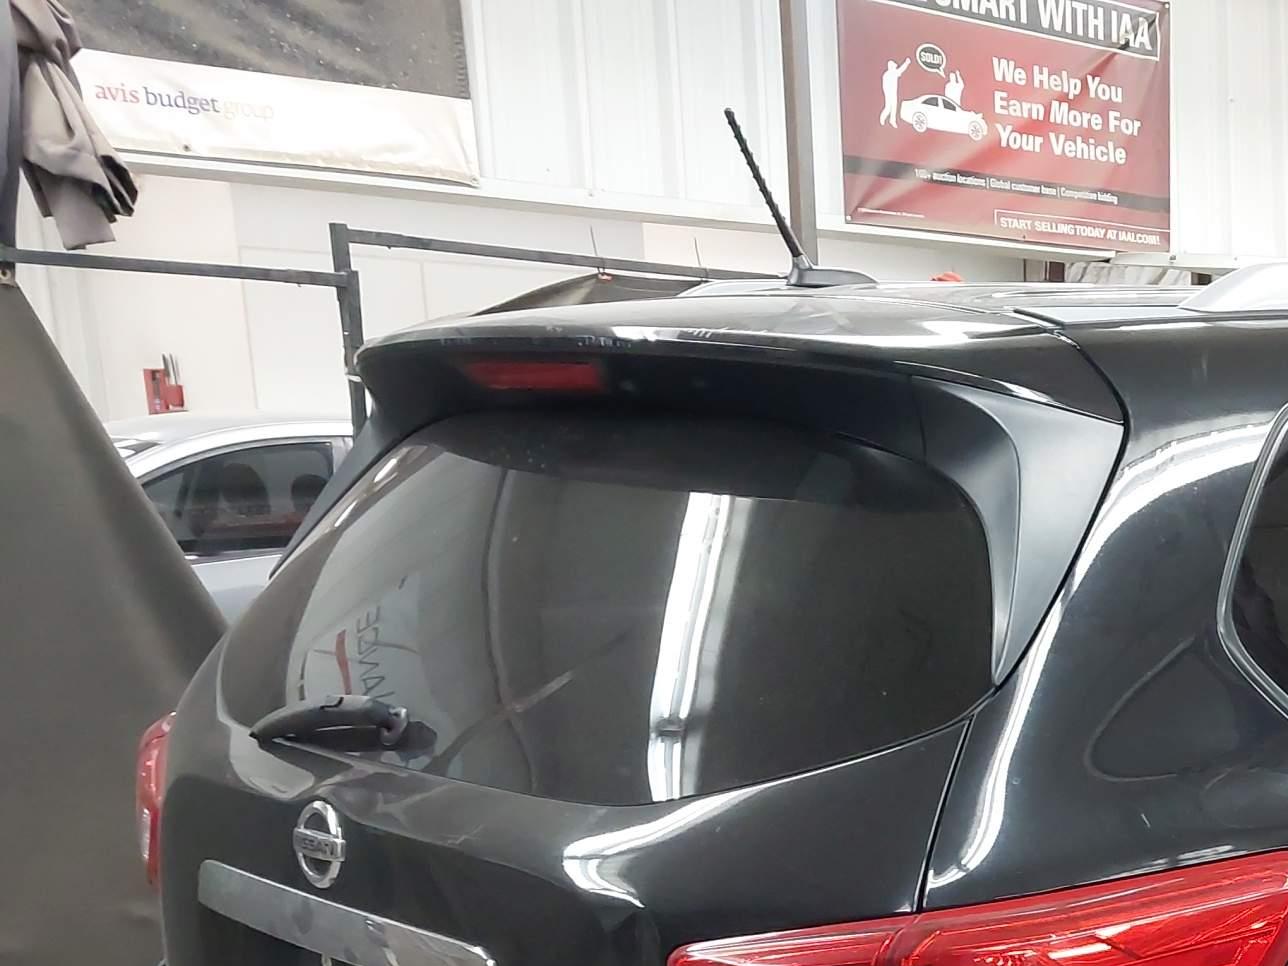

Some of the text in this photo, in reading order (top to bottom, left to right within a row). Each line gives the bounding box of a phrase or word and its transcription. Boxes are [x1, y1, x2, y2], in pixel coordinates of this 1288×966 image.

[1037, 0, 1104, 41] WITH
[1111, 10, 1153, 51] IAA
[95, 82, 140, 104] avis
[142, 86, 220, 115] budget
[992, 56, 1123, 103] We Help You
[993, 90, 1142, 136] Earn More For
[995, 123, 1127, 165] Your Vehicle
[1000, 217, 1033, 231] START
[1034, 220, 1075, 236] SELLING
[1075, 225, 1106, 239] TODAY
[1106, 229, 1118, 240] AT
